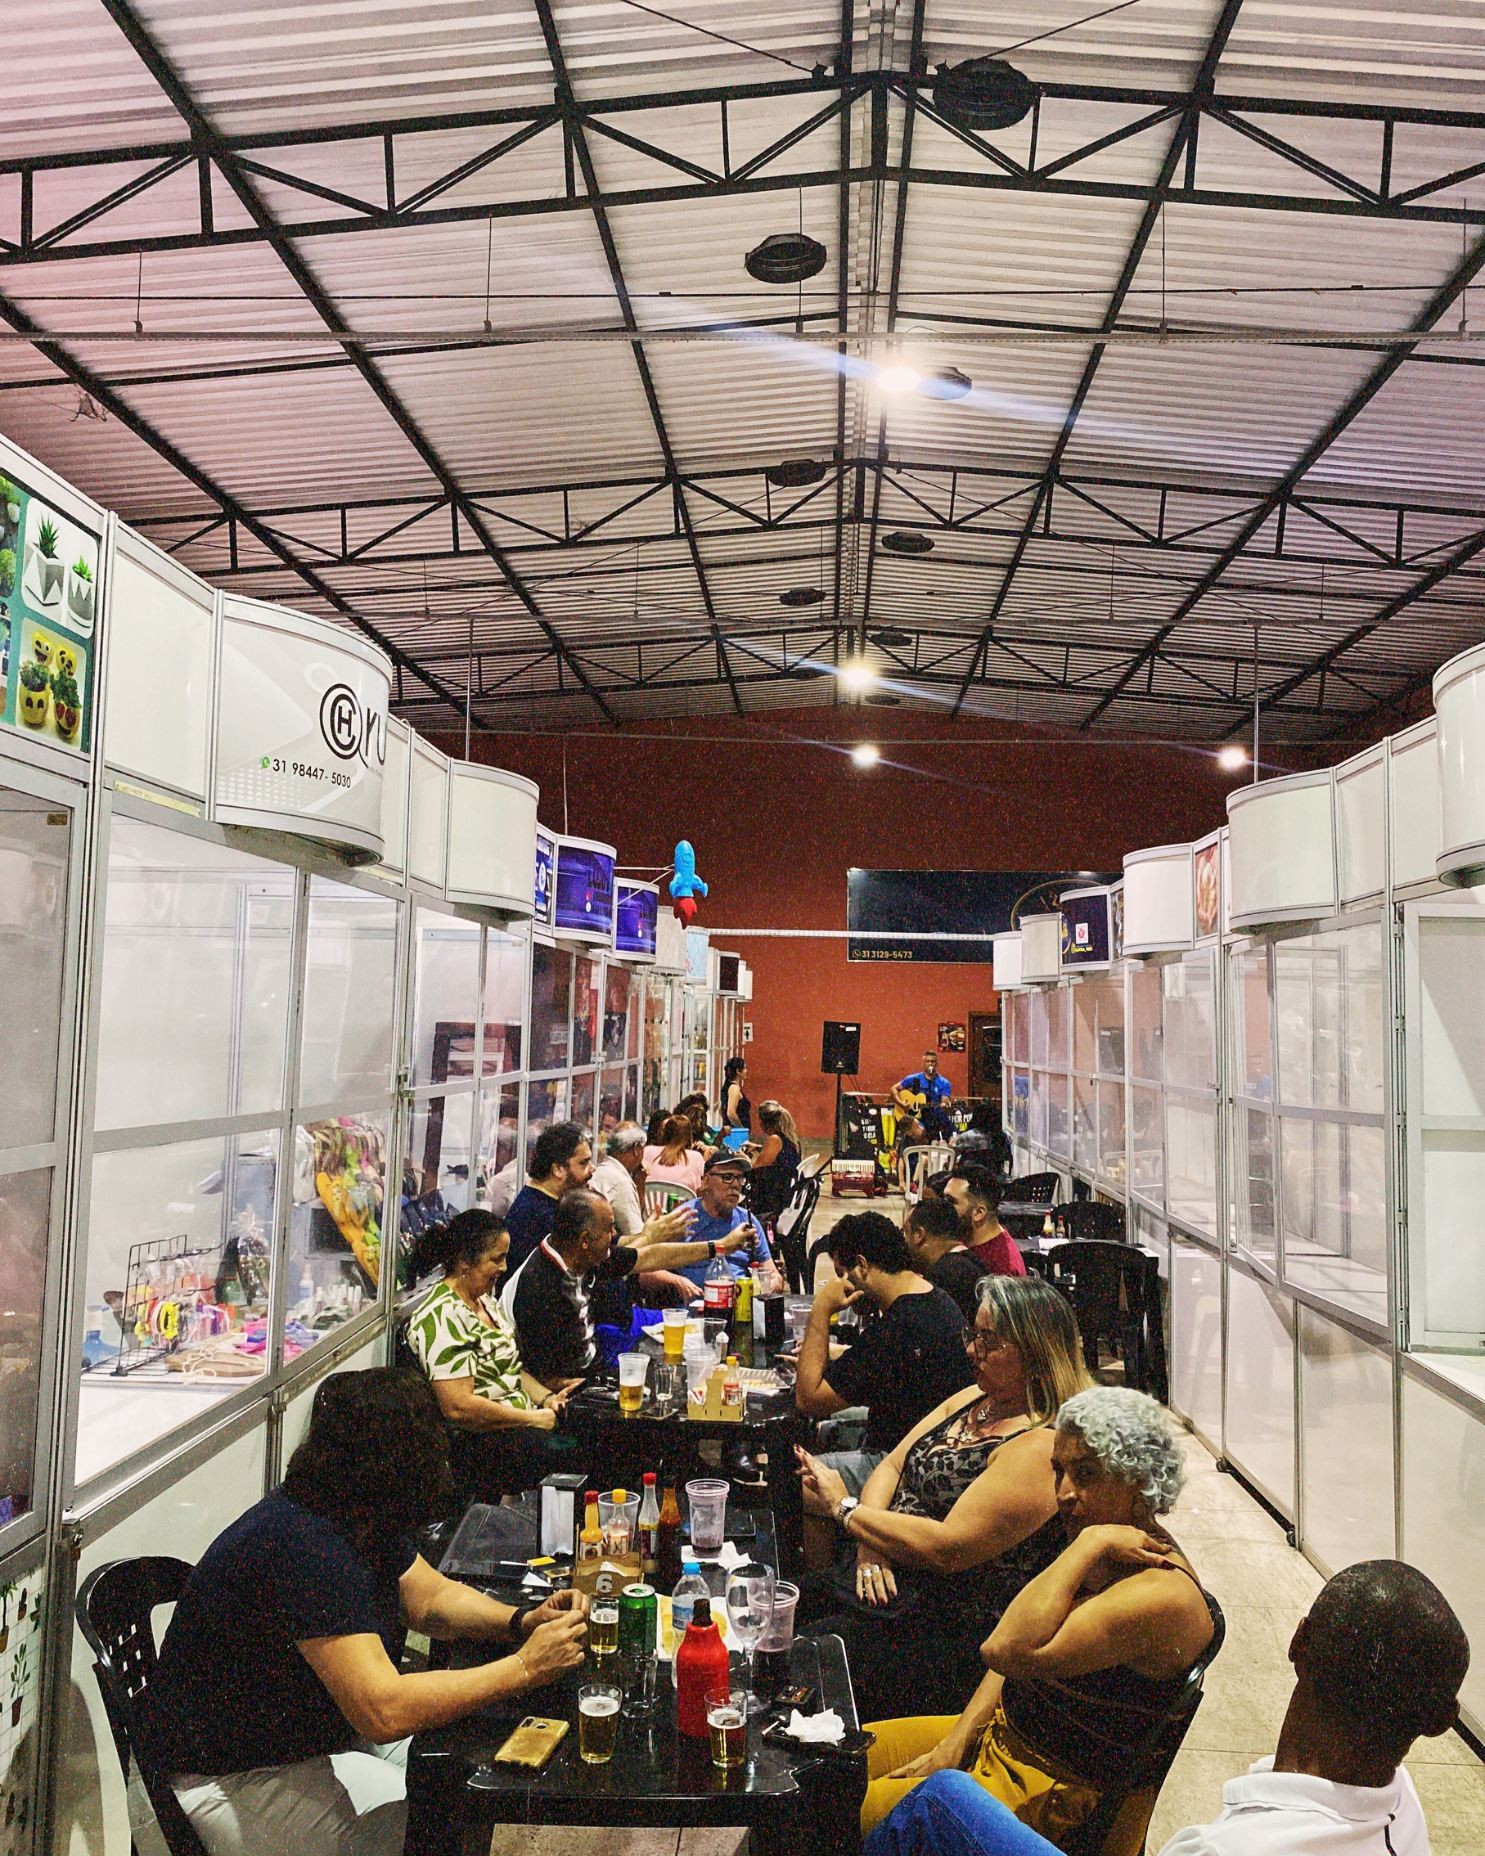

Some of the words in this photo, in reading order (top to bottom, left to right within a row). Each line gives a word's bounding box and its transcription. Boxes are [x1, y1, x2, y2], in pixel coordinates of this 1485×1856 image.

[272, 758, 287, 774] 31
[861, 950, 870, 959] 31
[871, 950, 913, 959] 3129-5473
[596, 1573, 613, 1593] 6
